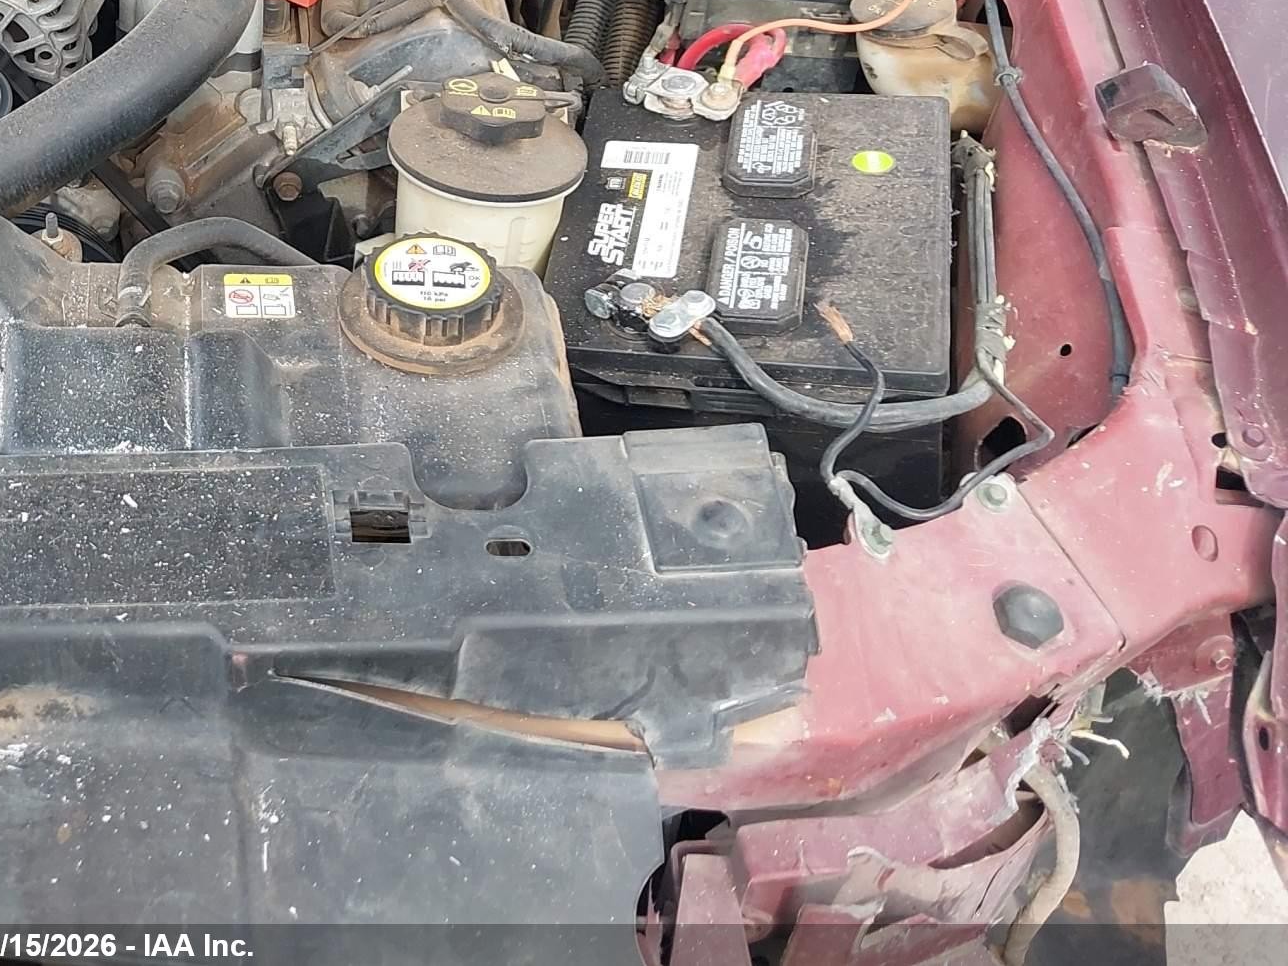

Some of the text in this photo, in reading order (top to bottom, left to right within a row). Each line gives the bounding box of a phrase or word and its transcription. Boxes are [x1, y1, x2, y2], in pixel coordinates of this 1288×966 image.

[587, 202, 617, 256] SUPER
[600, 203, 634, 266] START
[724, 227, 741, 257] POISON
[718, 263, 736, 297] DANGER
